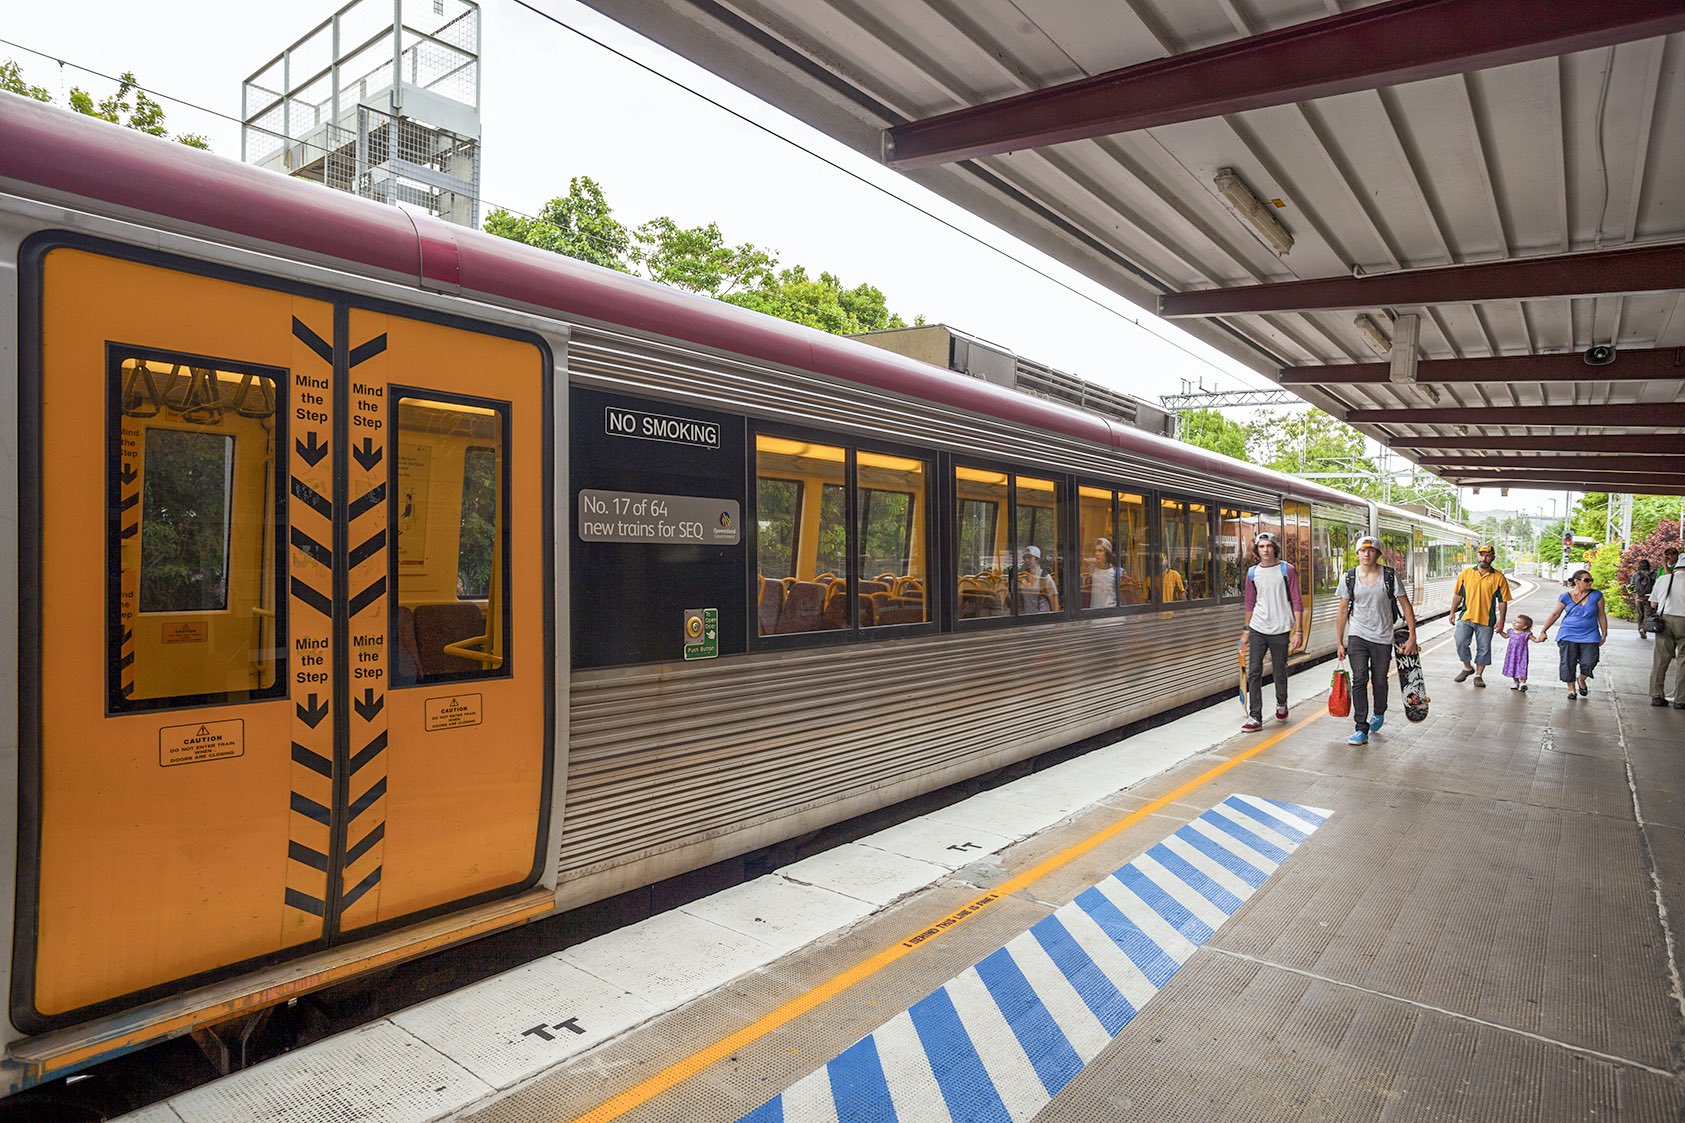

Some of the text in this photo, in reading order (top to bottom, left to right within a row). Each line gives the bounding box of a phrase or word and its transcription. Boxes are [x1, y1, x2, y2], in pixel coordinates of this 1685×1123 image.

[296, 375, 328, 389] Mind
[353, 383, 382, 396] Mind
[301, 393, 324, 404] the
[358, 400, 378, 412] the
[296, 408, 328, 424] Step
[354, 416, 382, 430] Step
[610, 412, 716, 444] NO SMOKING
[584, 496, 668, 517] No. 17 of 64
[584, 520, 704, 540] new trains for SEQ
[296, 638, 328, 650] Mind
[354, 634, 384, 646] Mind
[301, 656, 324, 666] the
[358, 652, 379, 662] the
[296, 672, 328, 684] Step
[354, 668, 384, 679] Step
[184, 735, 222, 744] CAUTION
[946, 842, 982, 852] TT
[908, 928, 940, 944] BEHIND
[936, 918, 956, 929] THIS
[520, 1016, 586, 1042] TT
